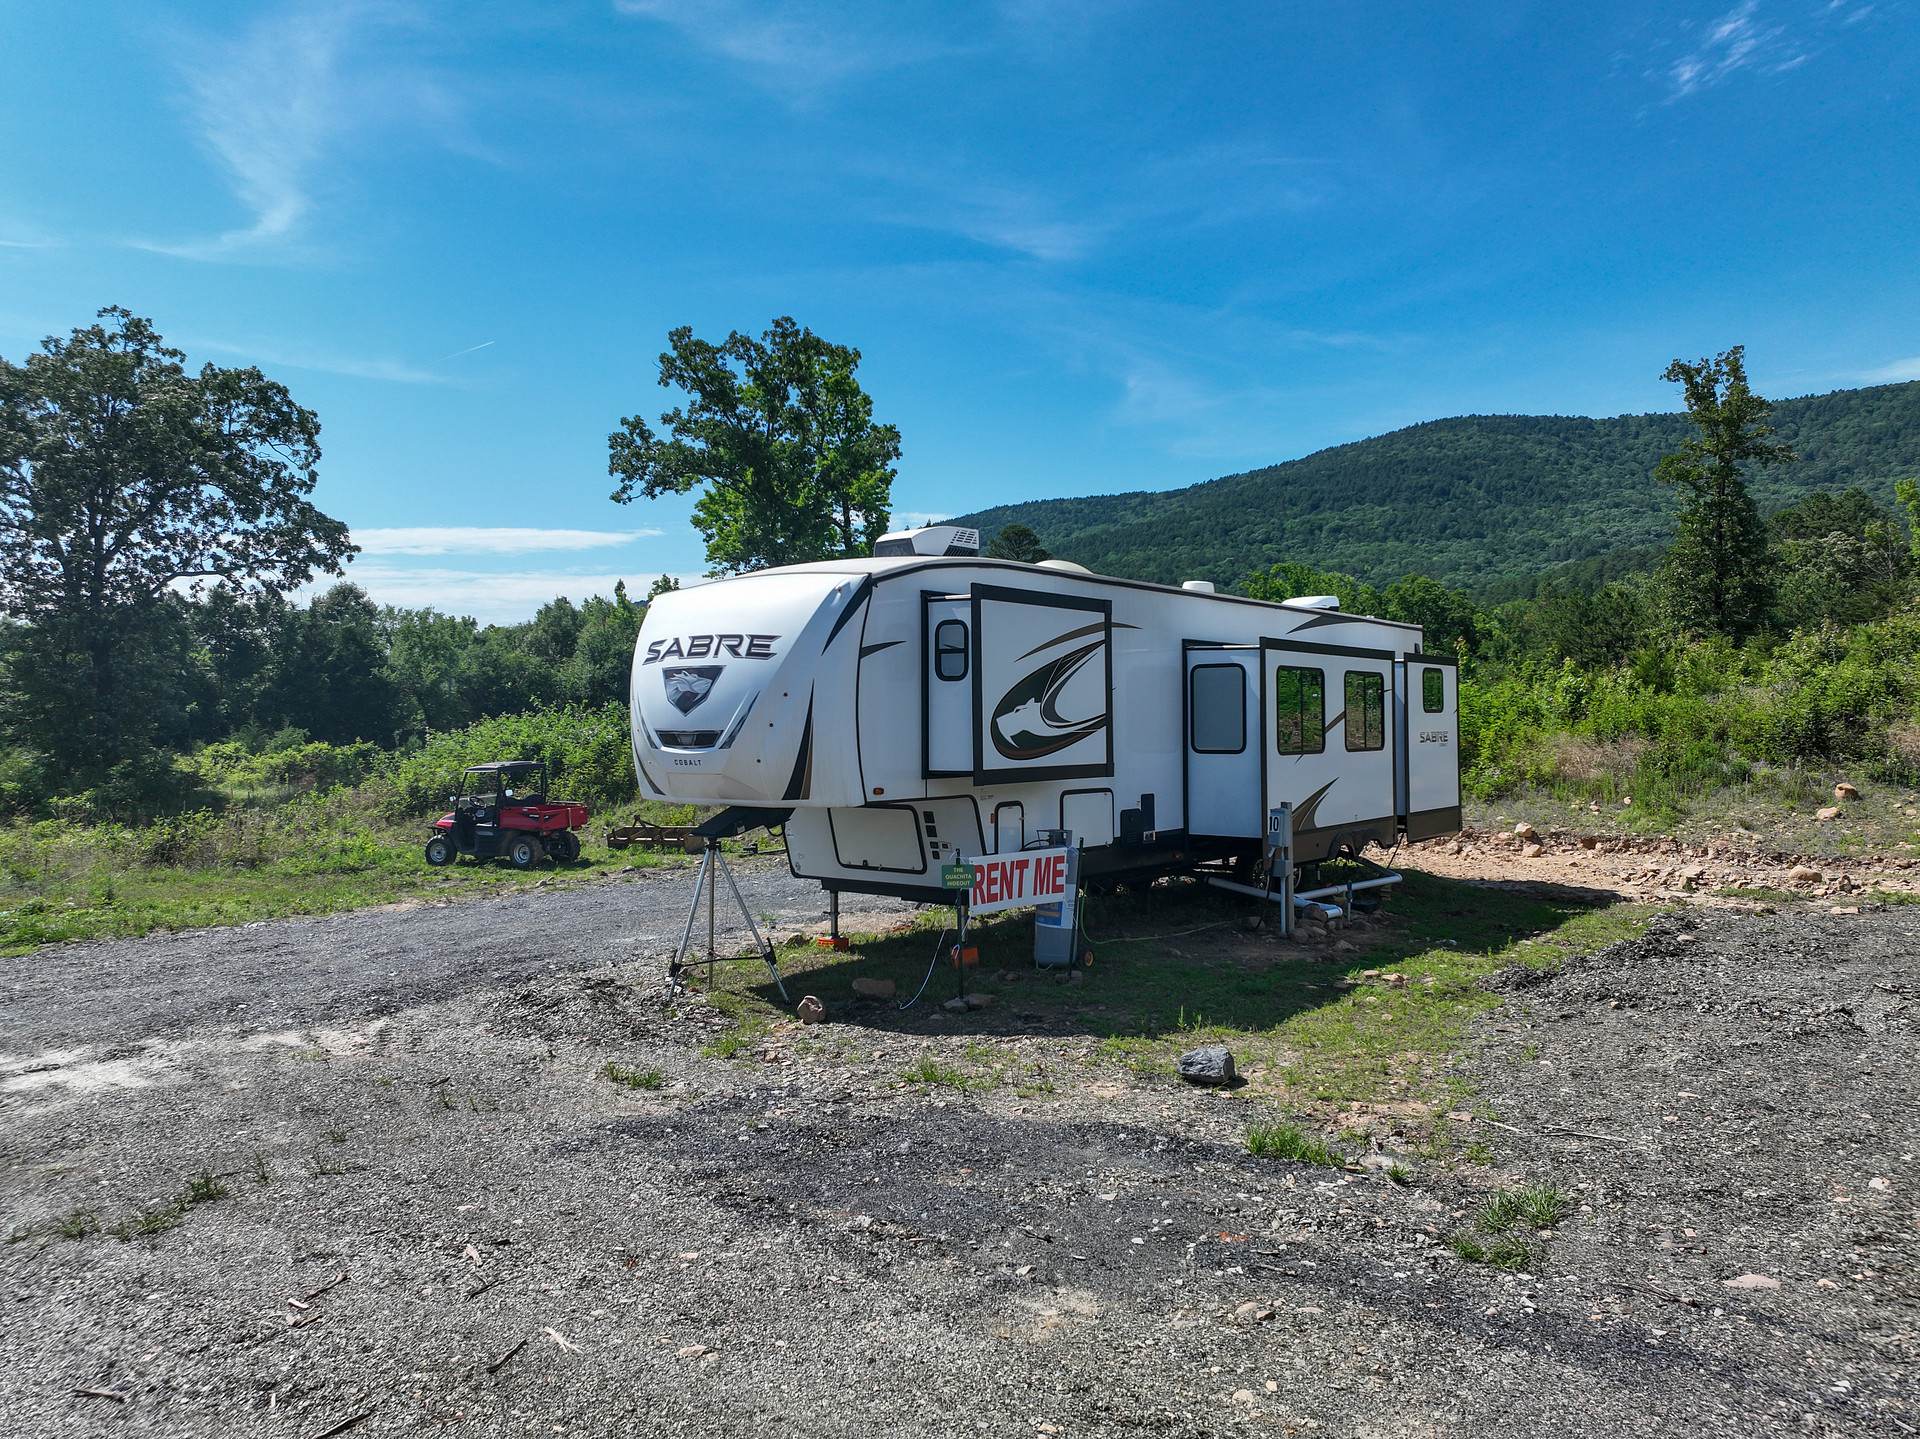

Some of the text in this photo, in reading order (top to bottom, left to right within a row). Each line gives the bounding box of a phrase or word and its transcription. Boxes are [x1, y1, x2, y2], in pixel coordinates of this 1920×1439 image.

[642, 634, 782, 666] SABRE
[1419, 730, 1449, 743] SABRE
[1269, 816, 1279, 831] 10
[973, 855, 1066, 906] RENT ME
